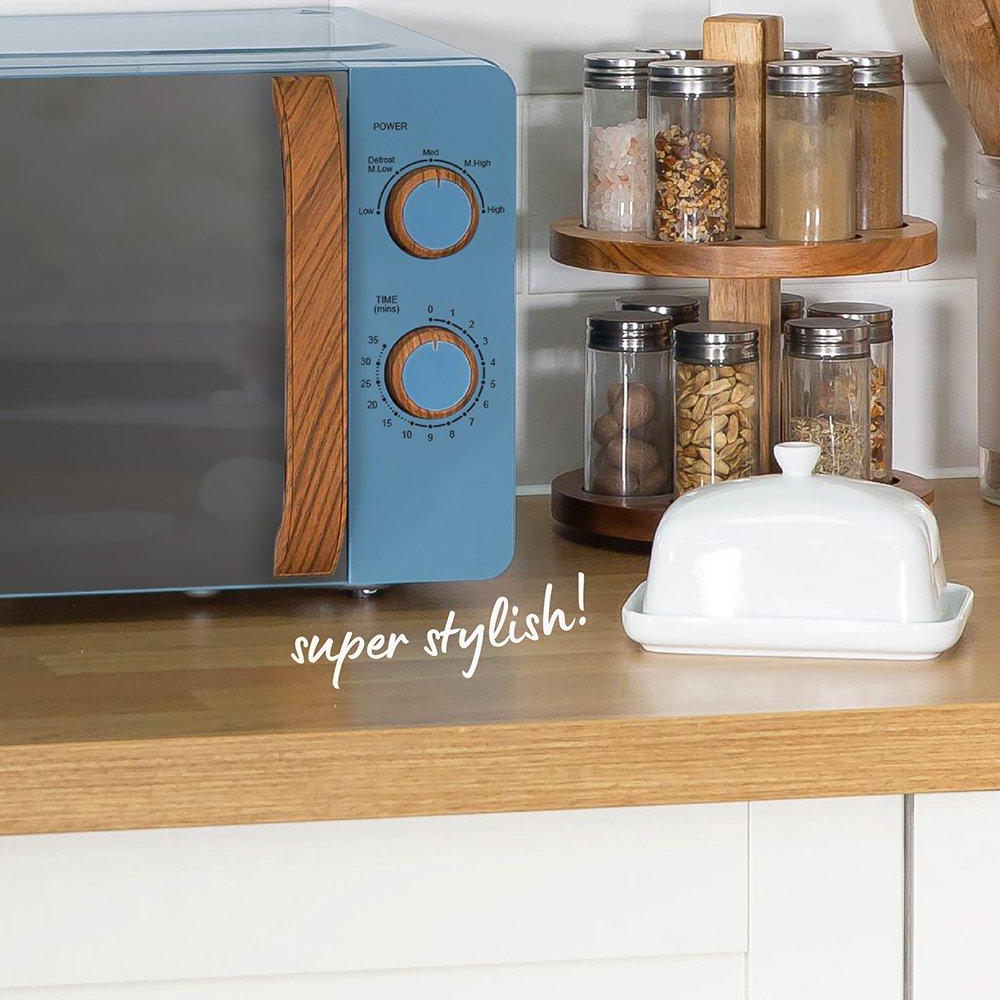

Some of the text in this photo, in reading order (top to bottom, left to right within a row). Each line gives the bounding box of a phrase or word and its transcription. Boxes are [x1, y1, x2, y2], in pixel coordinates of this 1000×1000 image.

[373, 121, 408, 131] POWER
[367, 156, 396, 164] Defrost
[464, 159, 491, 168] M.High
[367, 165, 393, 173] M.Low
[358, 207, 375, 215] Low
[487, 205, 505, 214] High
[375, 295, 398, 304] TIME
[373, 304, 400, 315] (mins)
[427, 304, 434, 314] 0
[450, 308, 455, 317] 1
[468, 320, 475, 329] 2
[367, 335, 379, 345] 35
[482, 337, 489, 346] 3
[360, 357, 371, 366] 30
[490, 358, 496, 366] 4
[360, 379, 372, 389] 25
[490, 379, 496, 389] 5
[367, 400, 378, 410] 20
[483, 400, 490, 409] 6
[382, 418, 393, 428] 15
[469, 417, 475, 427] 7
[402, 430, 413, 439] 10
[427, 432, 434, 442] 9
[449, 429, 456, 439] 8
